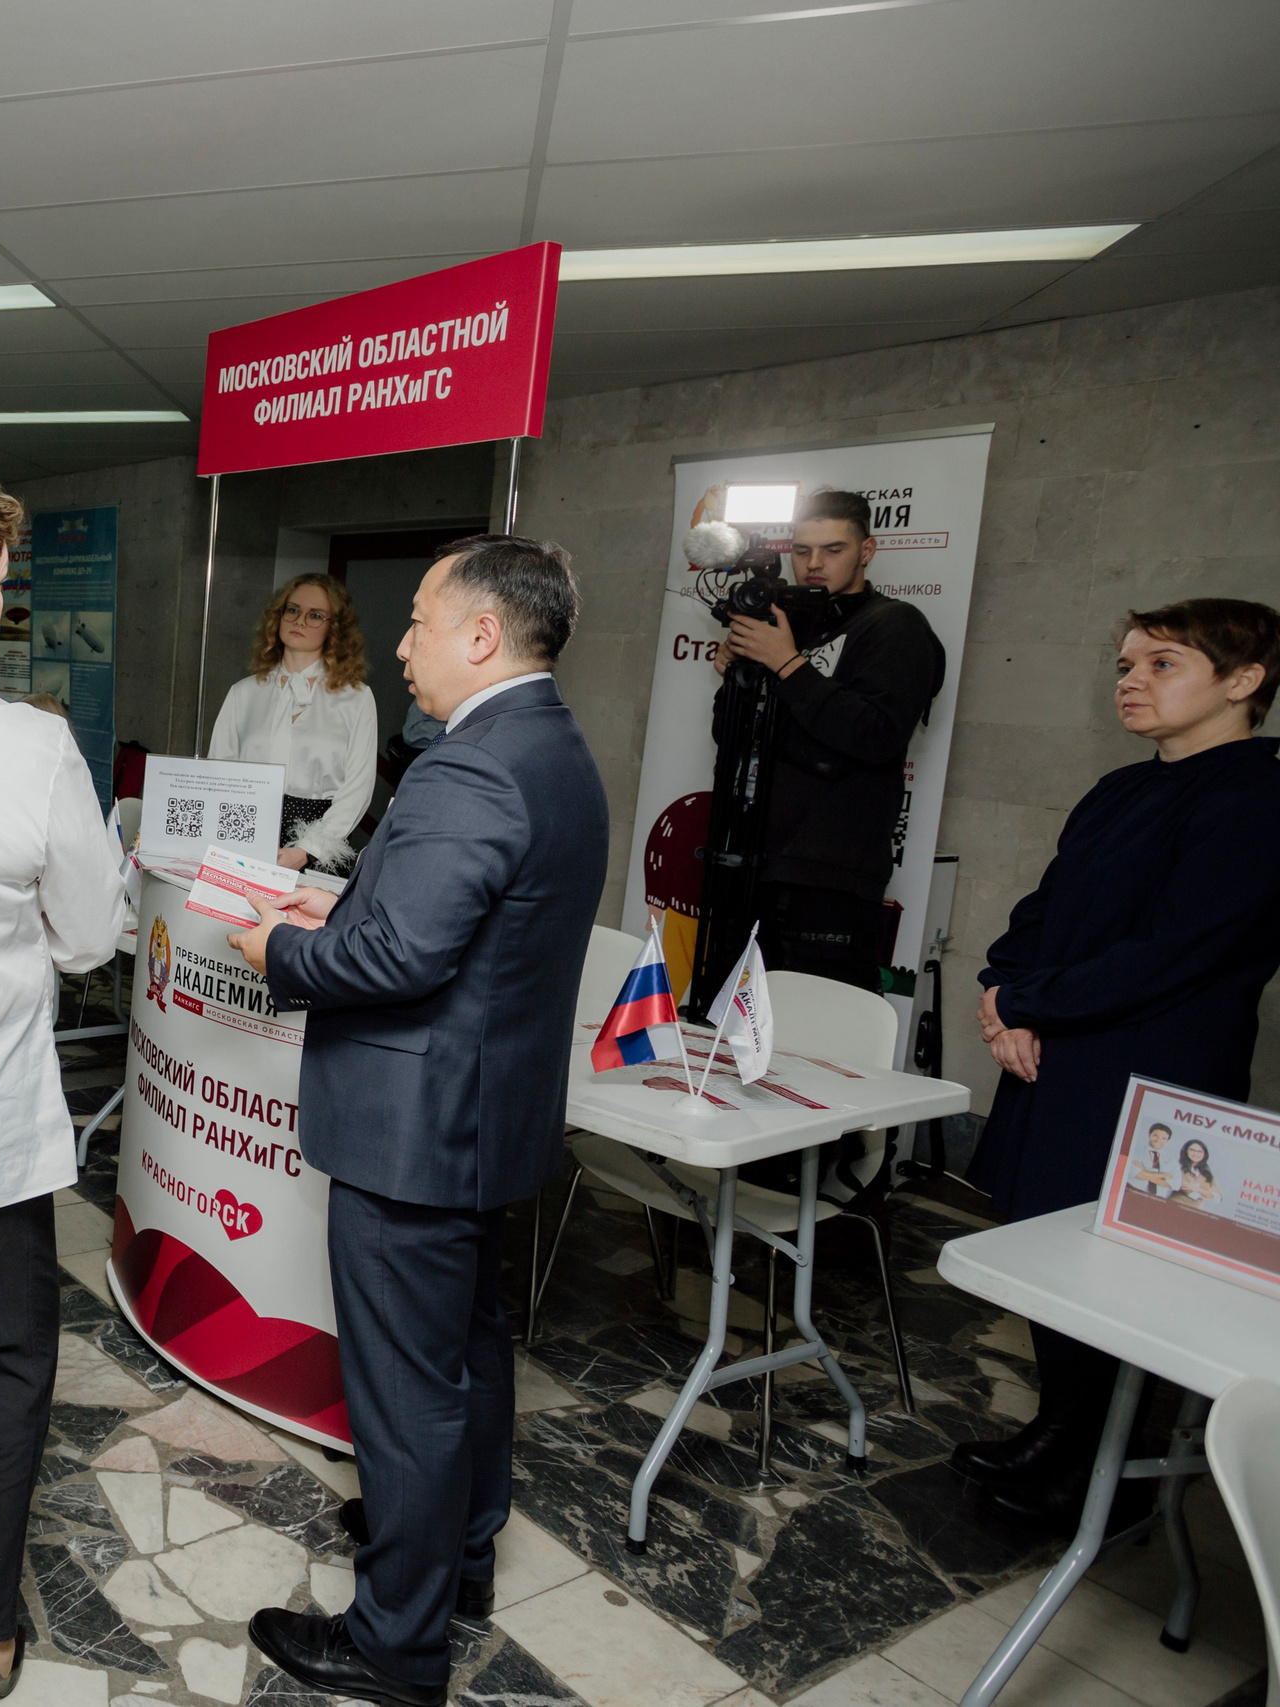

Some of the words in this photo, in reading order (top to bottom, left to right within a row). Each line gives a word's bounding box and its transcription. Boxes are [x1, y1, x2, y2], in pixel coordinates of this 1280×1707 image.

[218, 334, 353, 394] МОСКОВСКИЙ
[358, 300, 509, 369] ОБЛАСТНОЙ
[253, 386, 342, 425] ФИЛИАЛ
[347, 367, 452, 412] РАНХиГС
[889, 537, 941, 546] ОБЛАСТЬ
[874, 584, 942, 596] ОЛЬНИКОВ
[673, 634, 720, 661] Ста
[202, 870, 243, 889] БЕСПЛАТНОЕ
[175, 946, 268, 985] ПРЕЗИДЕНТСКА
[174, 963, 278, 1018] АКАДЕМИЯ
[206, 1008, 259, 1031] МОСКОВСКАЯ
[262, 1026, 305, 1042] ОБЛАСТЬ
[131, 1015, 195, 1096] МОСКОВСКИЙ
[201, 1075, 299, 1132] ОБЛАСТ
[137, 1072, 187, 1133] ФИЛИАЛ
[192, 1113, 302, 1177] РАНХиГС
[1174, 1109, 1217, 1129] МБУ
[141, 1149, 250, 1234] КРАСНОГОРСК
